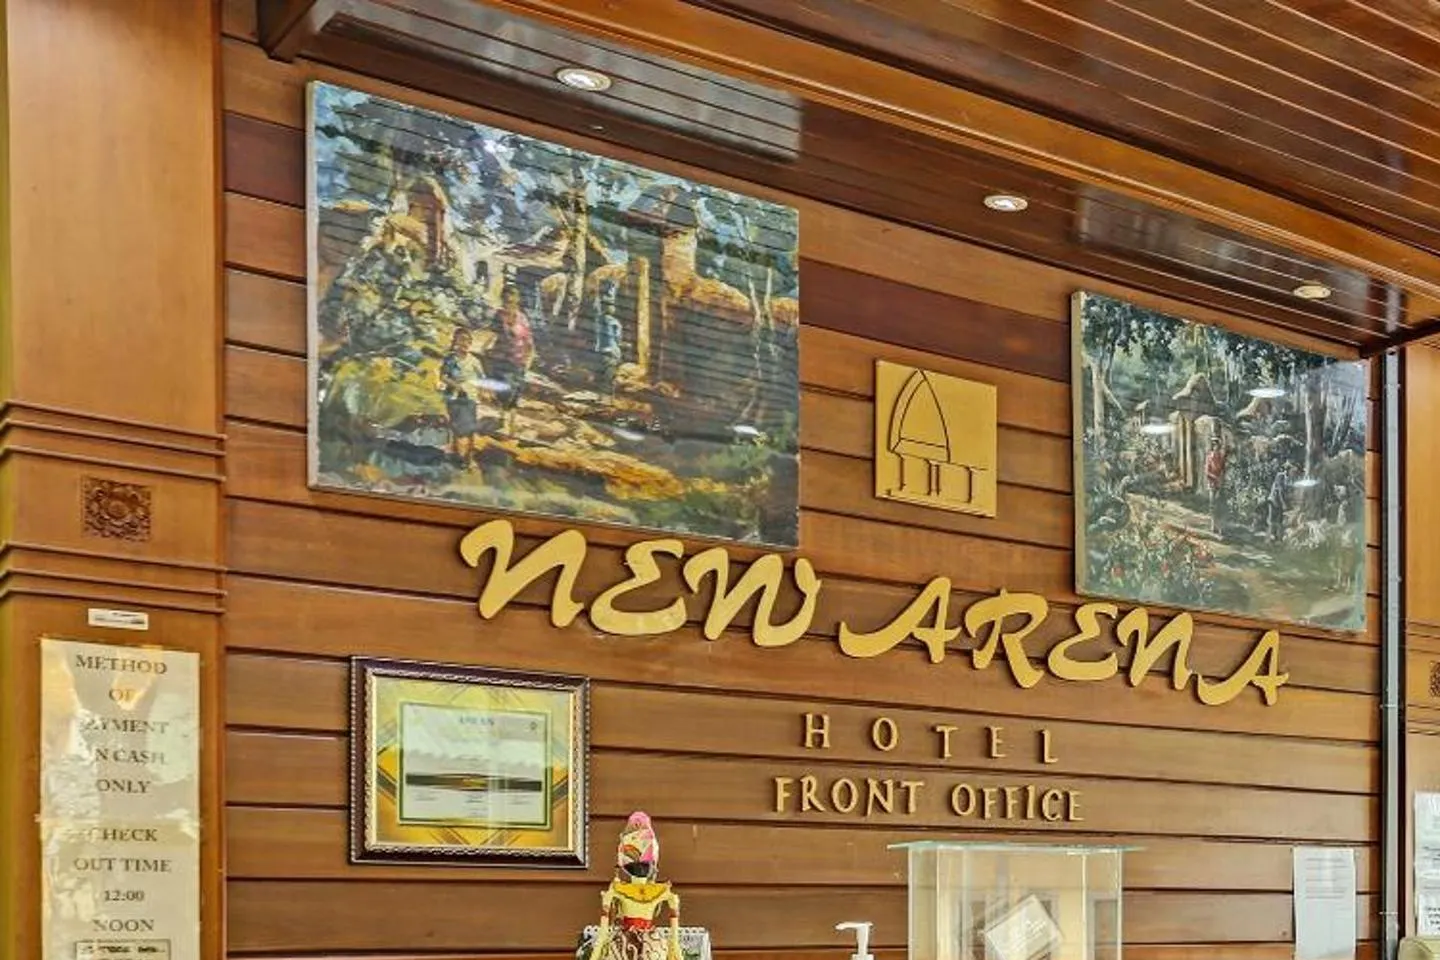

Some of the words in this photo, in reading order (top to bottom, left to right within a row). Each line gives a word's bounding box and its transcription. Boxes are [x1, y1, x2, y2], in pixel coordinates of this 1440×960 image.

[460, 519, 821, 647] NEW
[838, 576, 1289, 706] ARENA
[76, 654, 168, 675] METHOD
[80, 718, 169, 734] AYMENT
[803, 713, 1059, 764] HOTEL
[96, 778, 151, 794] ONLY
[774, 775, 925, 817] FRONT
[951, 782, 1085, 822] OFFICE
[73, 857, 117, 871] OUT
[119, 858, 172, 873] TIME
[104, 890, 145, 901] 12:00
[93, 918, 154, 933] NOON
